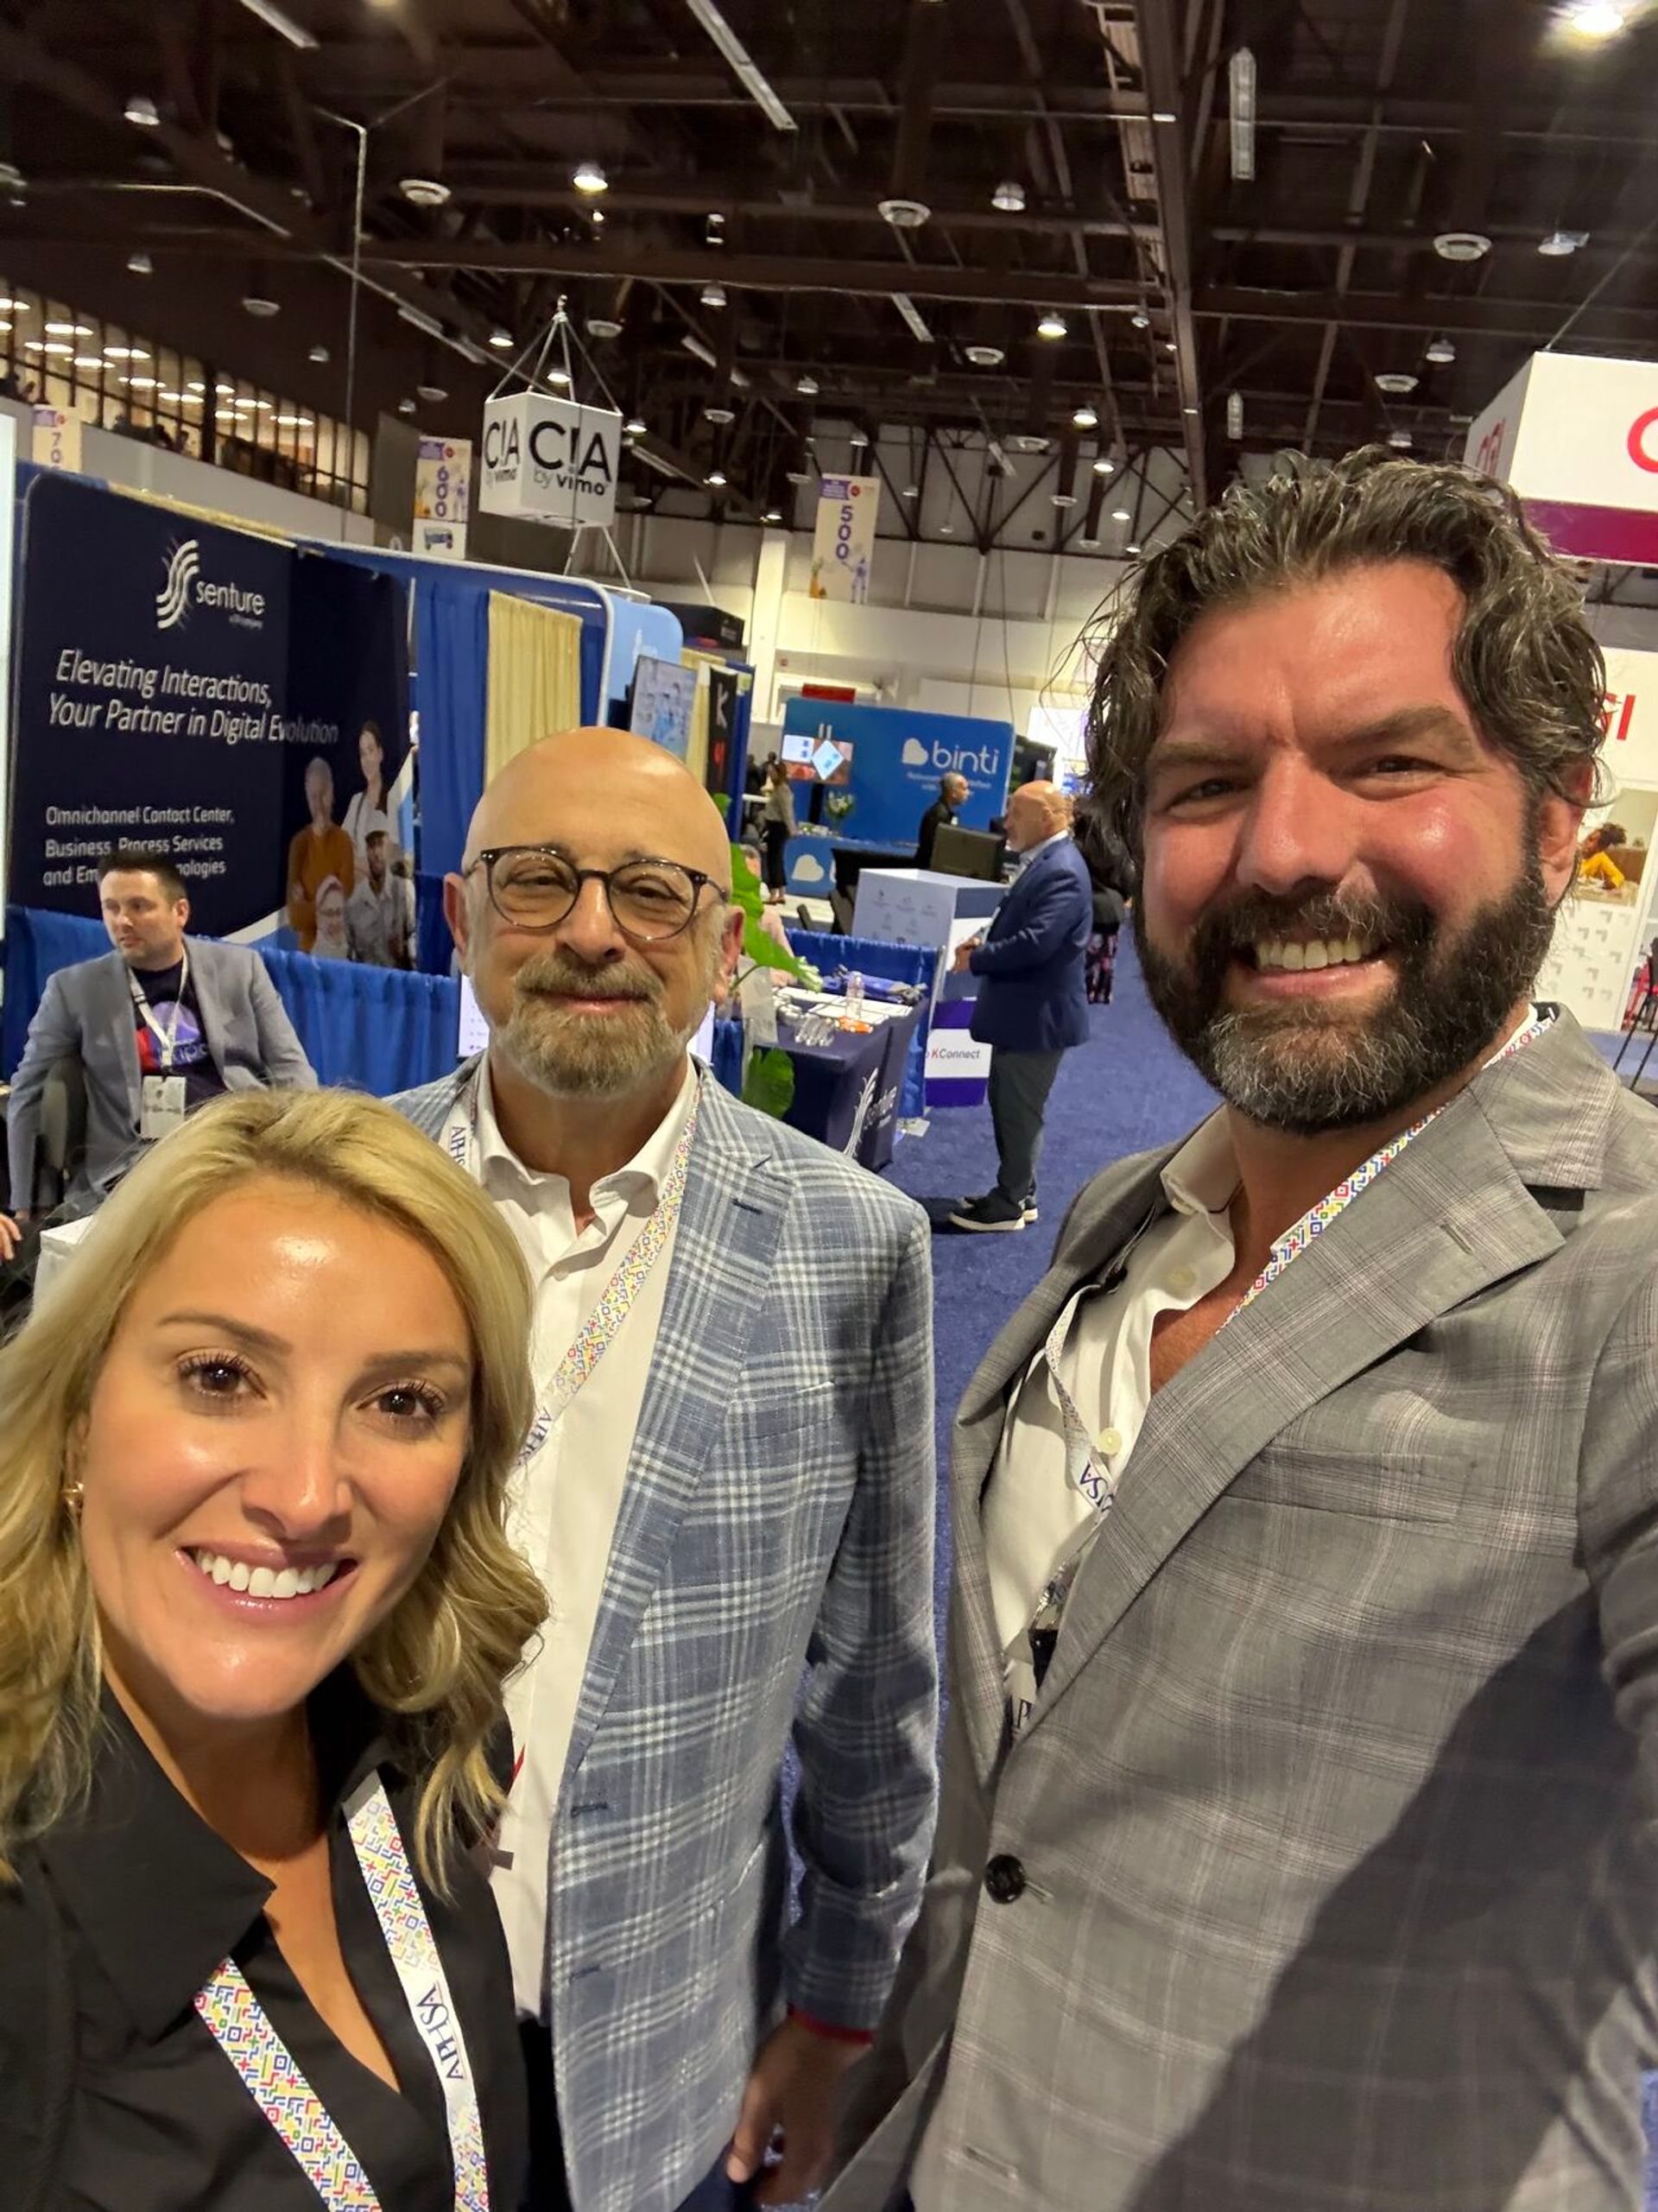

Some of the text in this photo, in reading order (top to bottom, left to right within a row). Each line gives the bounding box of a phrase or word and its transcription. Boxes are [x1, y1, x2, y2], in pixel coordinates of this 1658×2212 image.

[435, 466, 449, 517] 600
[836, 505, 852, 560] 500
[196, 580, 265, 615] senture
[56, 649, 272, 709] Elevating Interactions,
[49, 692, 339, 745] Your Partner in Digital Evolution
[933, 740, 999, 775] binti
[46, 805, 141, 826] Omnichannel
[142, 806, 190, 824] Contact
[45, 838, 111, 858] Business
[173, 834, 223, 852] Services
[43, 867, 72, 886] and
[932, 1048, 980, 1059] KConnect
